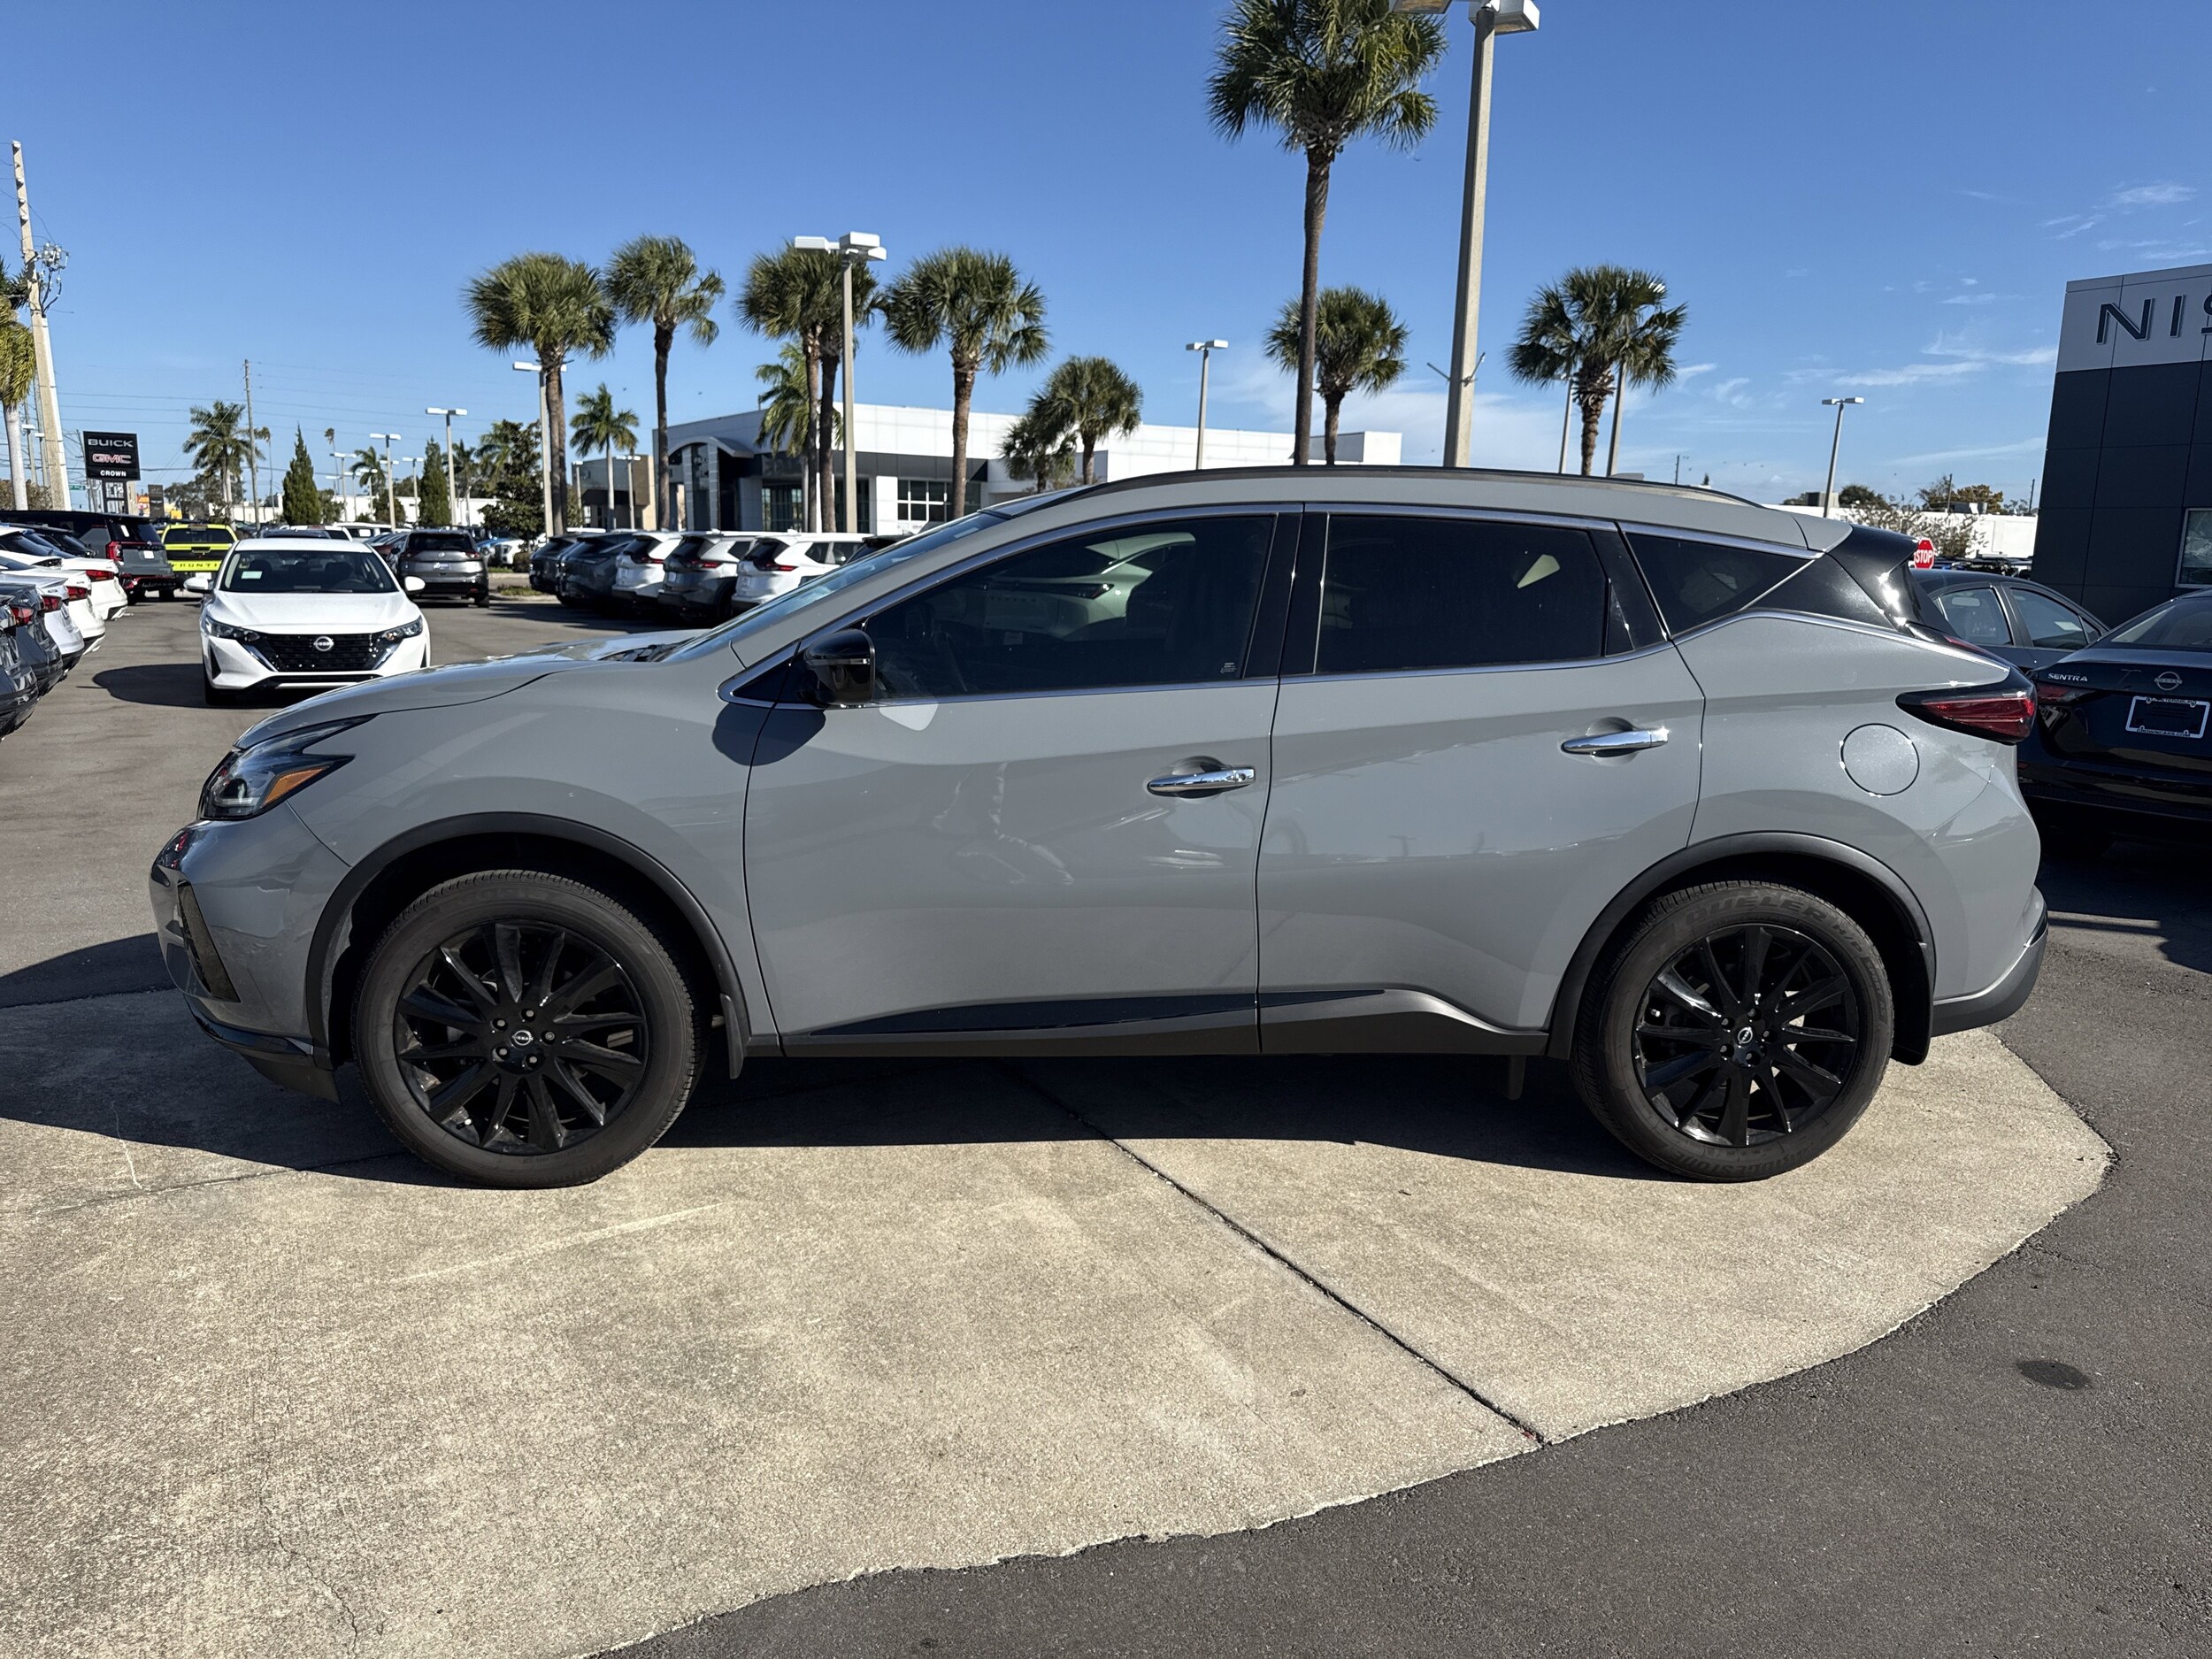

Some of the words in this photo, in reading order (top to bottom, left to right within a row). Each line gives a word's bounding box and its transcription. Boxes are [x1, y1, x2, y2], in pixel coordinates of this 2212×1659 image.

[88, 438, 134, 448] BUICK
[92, 453, 132, 465] GMC
[1916, 549, 1933, 564] STOP
[2047, 672, 2088, 682] SENTRA
[1685, 895, 1828, 925] DUELER
[1832, 924, 1863, 953] H/P
